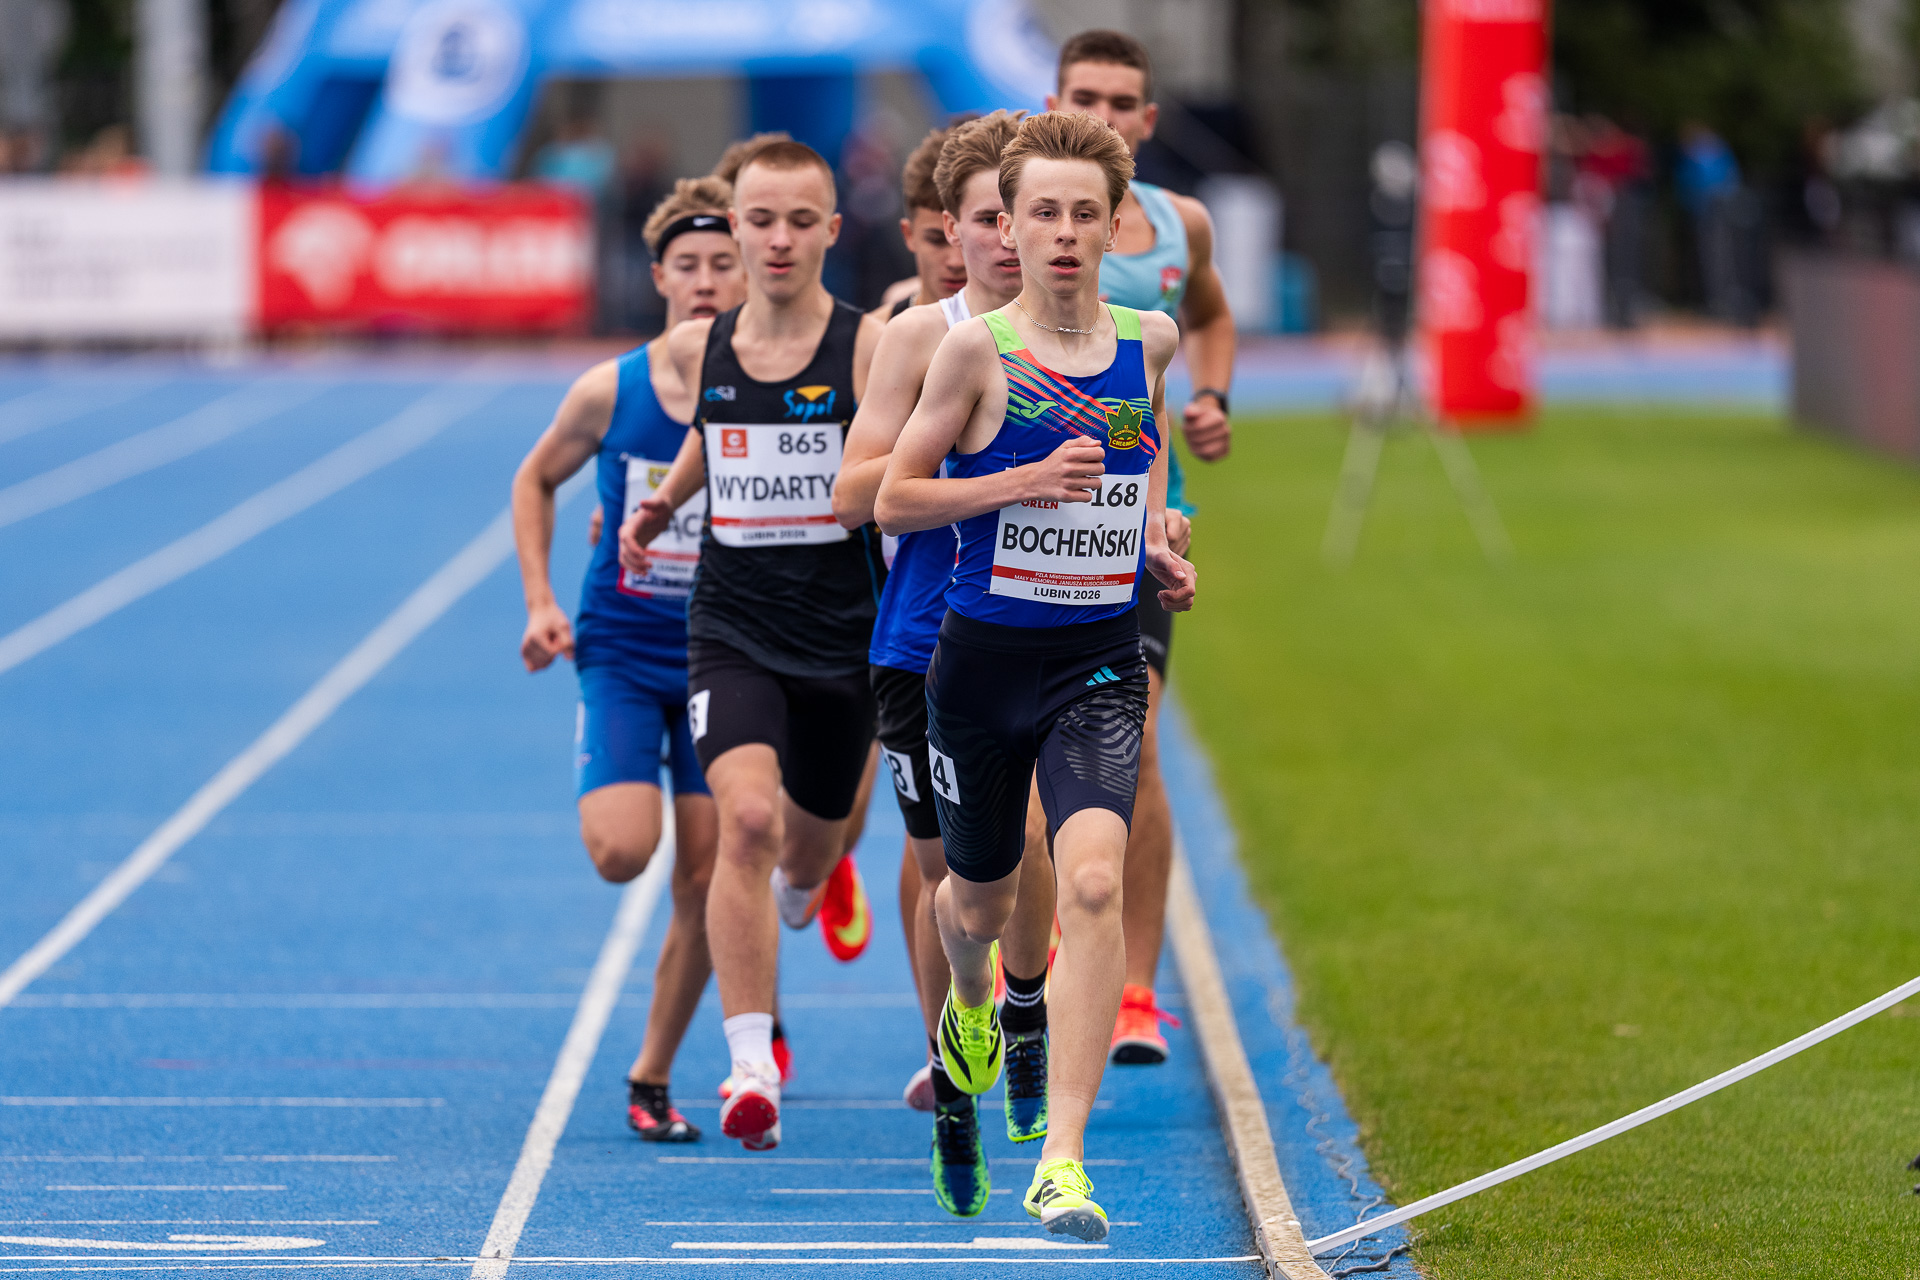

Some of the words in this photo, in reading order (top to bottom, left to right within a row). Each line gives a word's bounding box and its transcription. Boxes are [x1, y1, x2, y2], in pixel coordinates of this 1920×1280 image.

[778, 432, 827, 454] 865
[715, 472, 836, 501] WYDARTY
[1090, 483, 1139, 507] 168
[1002, 523, 1137, 557] BOCHEŃSKI
[1033, 586, 1071, 599] LUBIN
[1073, 590, 1101, 600] 2026
[932, 754, 951, 796] 4
